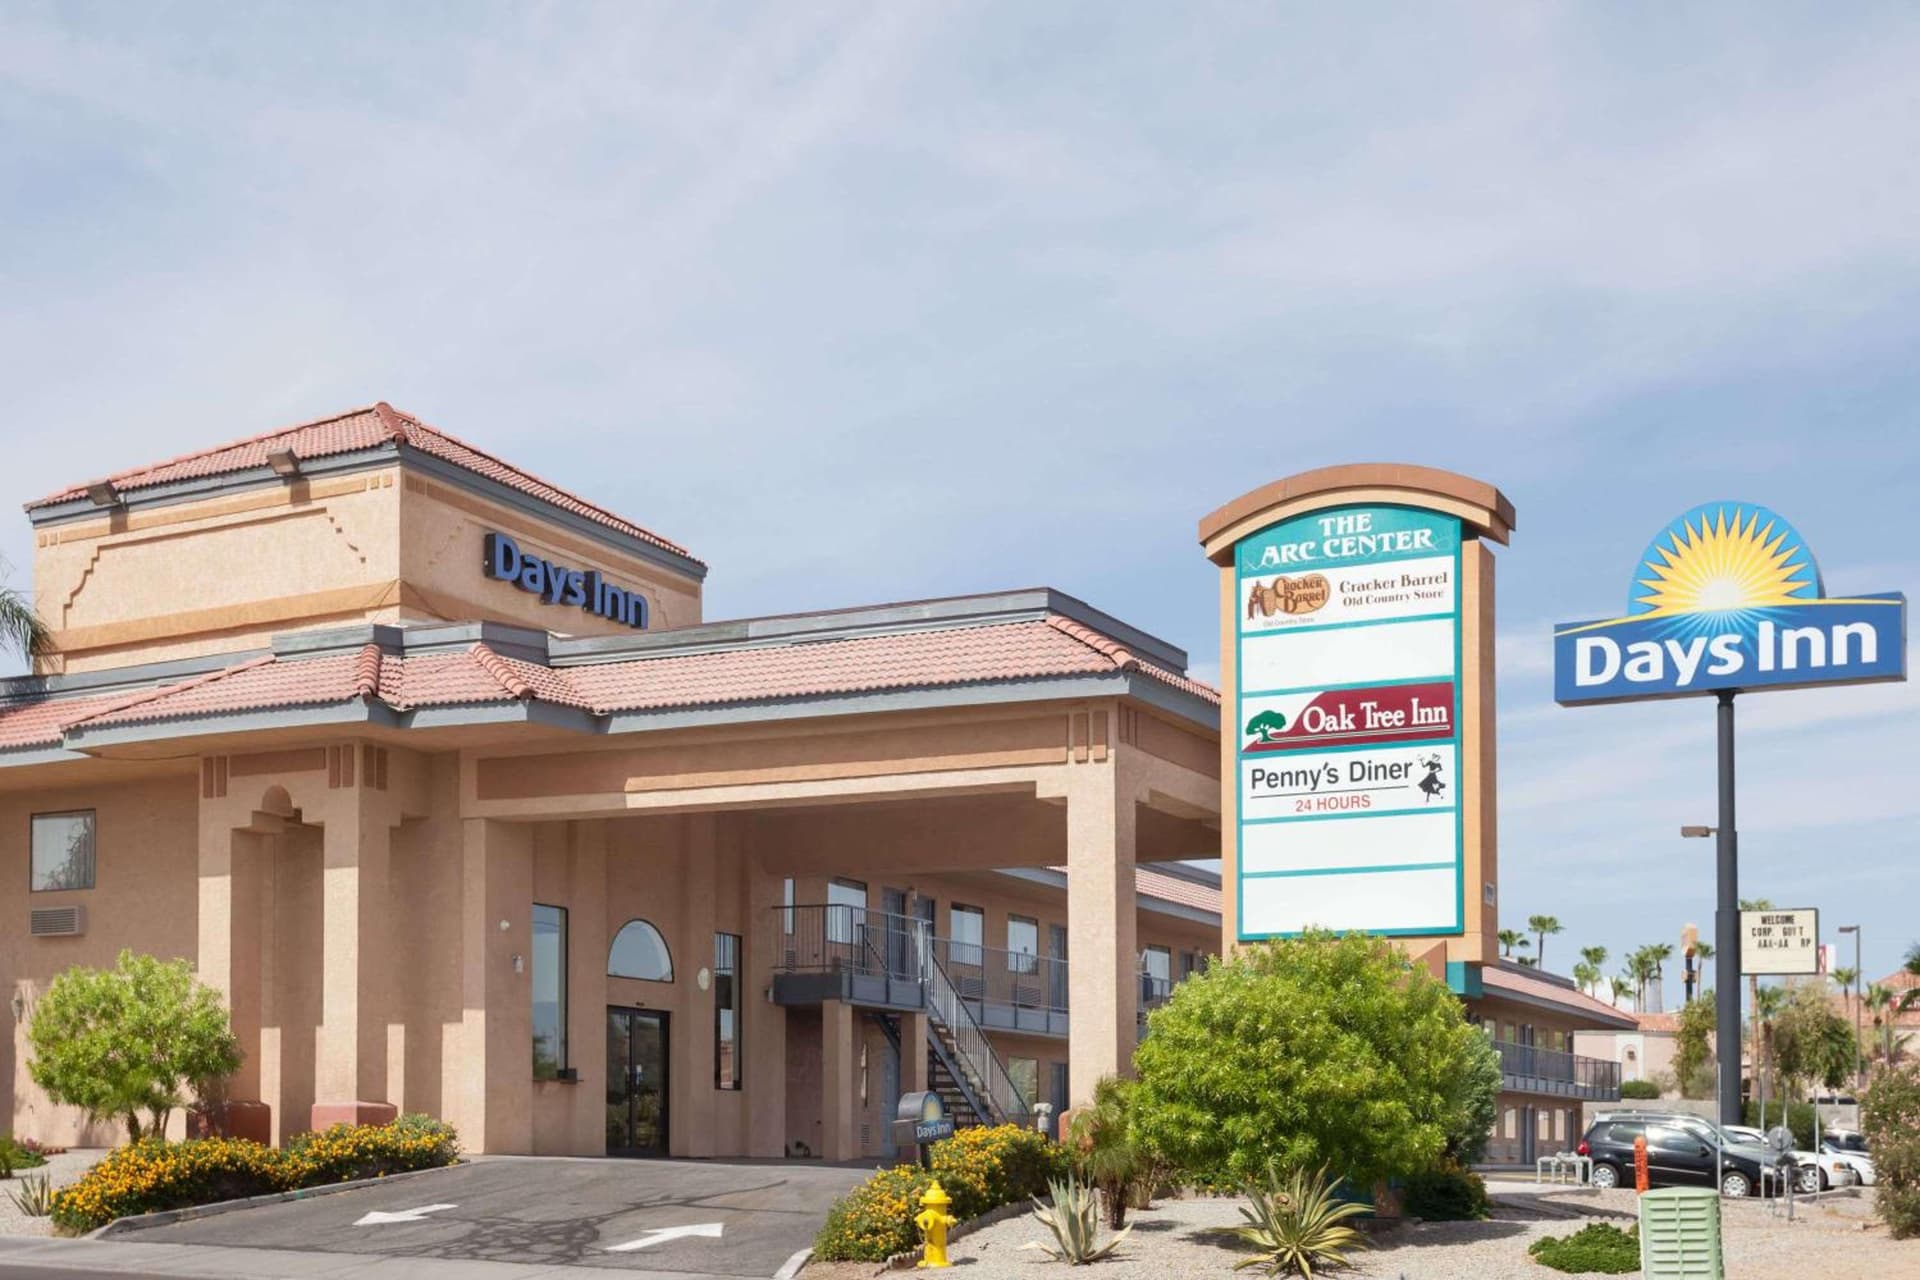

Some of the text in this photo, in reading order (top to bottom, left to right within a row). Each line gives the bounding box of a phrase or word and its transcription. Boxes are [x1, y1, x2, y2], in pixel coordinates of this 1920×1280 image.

[1318, 513, 1372, 537] THE
[1261, 528, 1434, 566] ARC CENTER
[488, 532, 649, 630] Days Inn
[1340, 572, 1448, 594] Cracker Barrel
[1343, 589, 1445, 607] Old Country Store
[1575, 620, 1878, 687] Days Inn
[1302, 698, 1449, 734] Oak Tree Inn
[1250, 760, 1413, 791] Penny's Diner
[1295, 795, 1371, 812] 24 HOURS
[1761, 915, 1794, 925] WELCOME
[916, 1123, 951, 1138] Days Inn
